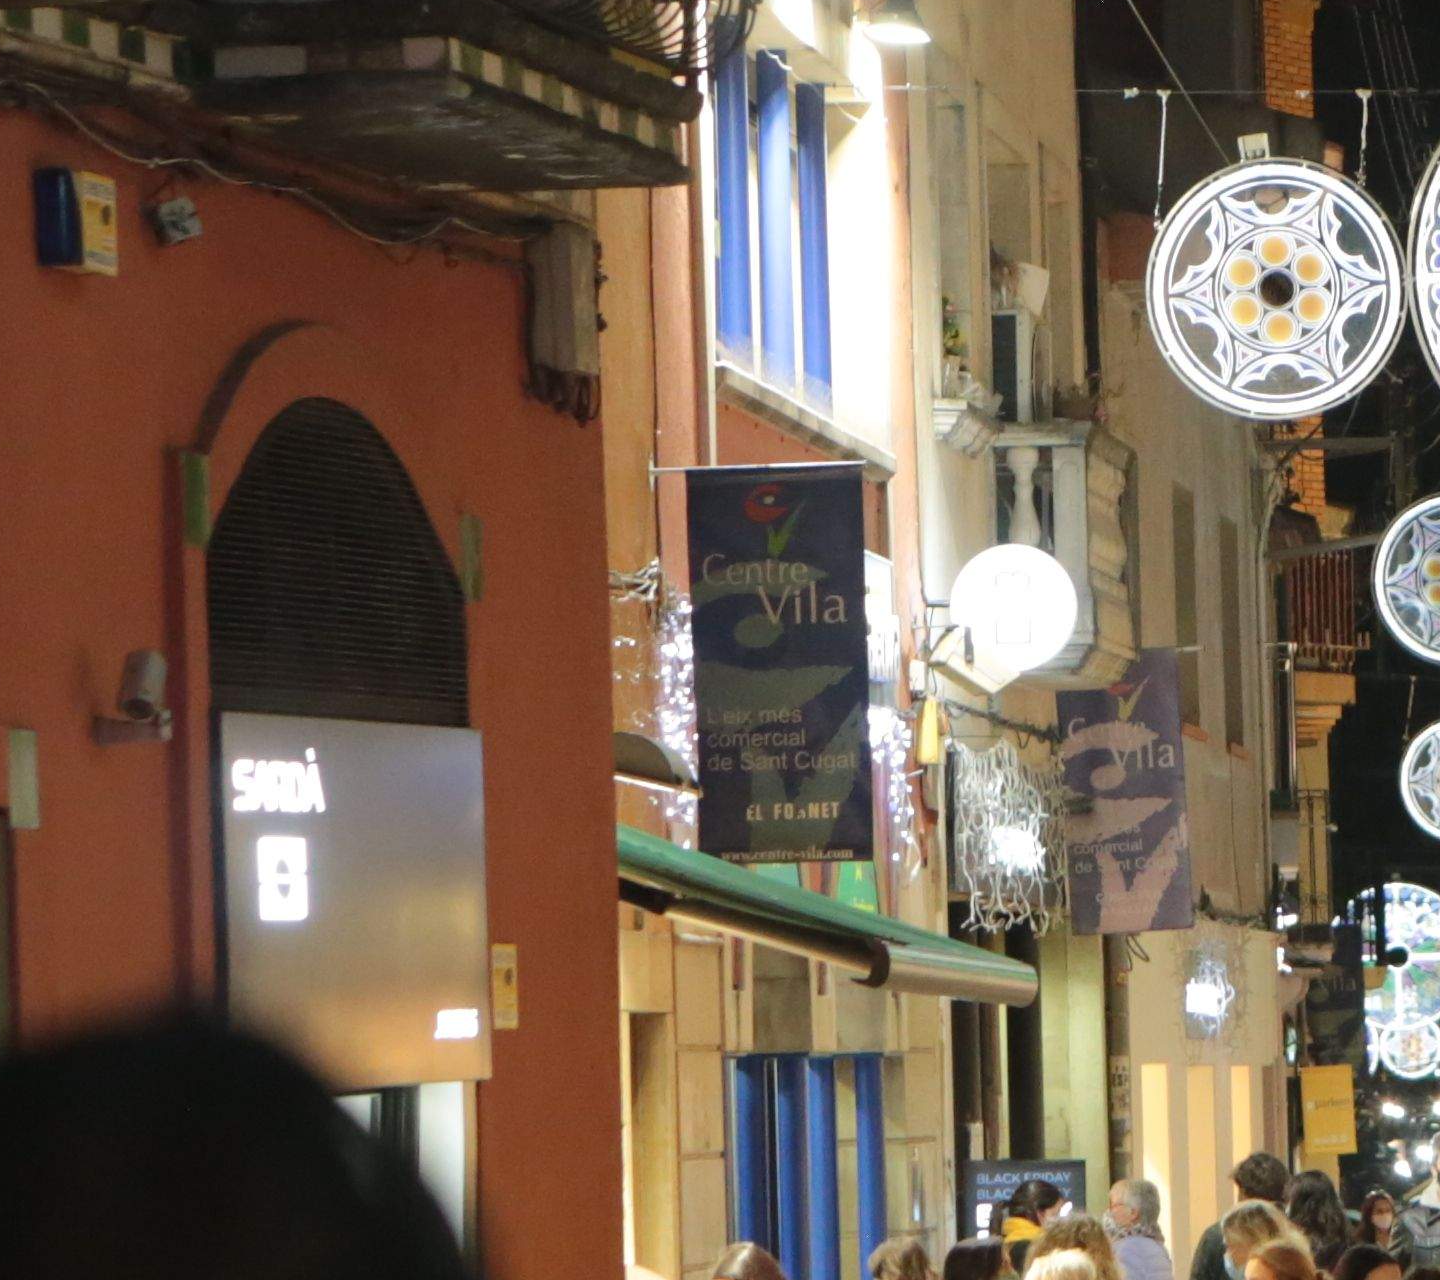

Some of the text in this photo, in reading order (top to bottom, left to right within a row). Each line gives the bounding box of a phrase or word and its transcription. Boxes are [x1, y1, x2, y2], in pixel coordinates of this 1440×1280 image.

[702, 553, 809, 586] Centre
[756, 581, 847, 624] Vila
[707, 728, 806, 749] comercial
[707, 749, 857, 773] de Sant Cugat
[746, 804, 764, 821] EL
[976, 1171, 1072, 1185] BLACK FRIDAY
[976, 1187, 1014, 1200] BLAC
